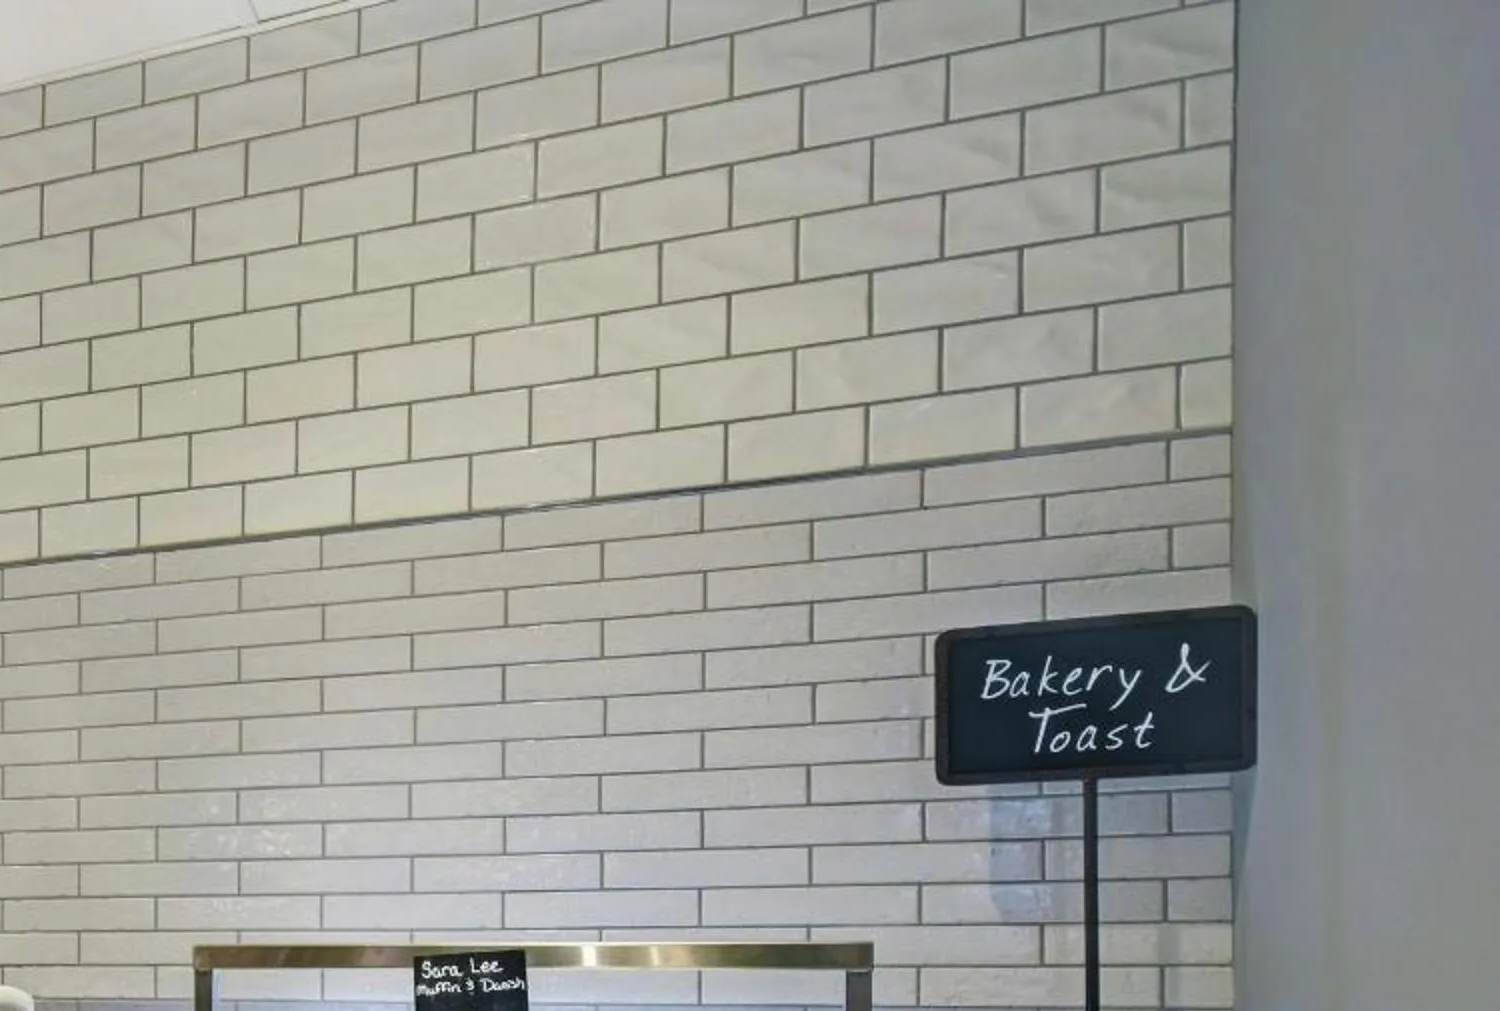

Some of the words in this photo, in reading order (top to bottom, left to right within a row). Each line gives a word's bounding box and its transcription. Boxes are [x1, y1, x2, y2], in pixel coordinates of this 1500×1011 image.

[980, 655, 1143, 711] Bakery
[1164, 642, 1212, 694] &
[1028, 703, 1156, 754] Toast
[421, 960, 464, 979] Sara
[469, 956, 504, 974] Lee
[416, 980, 462, 997] Muffin
[480, 976, 525, 993] Danish
